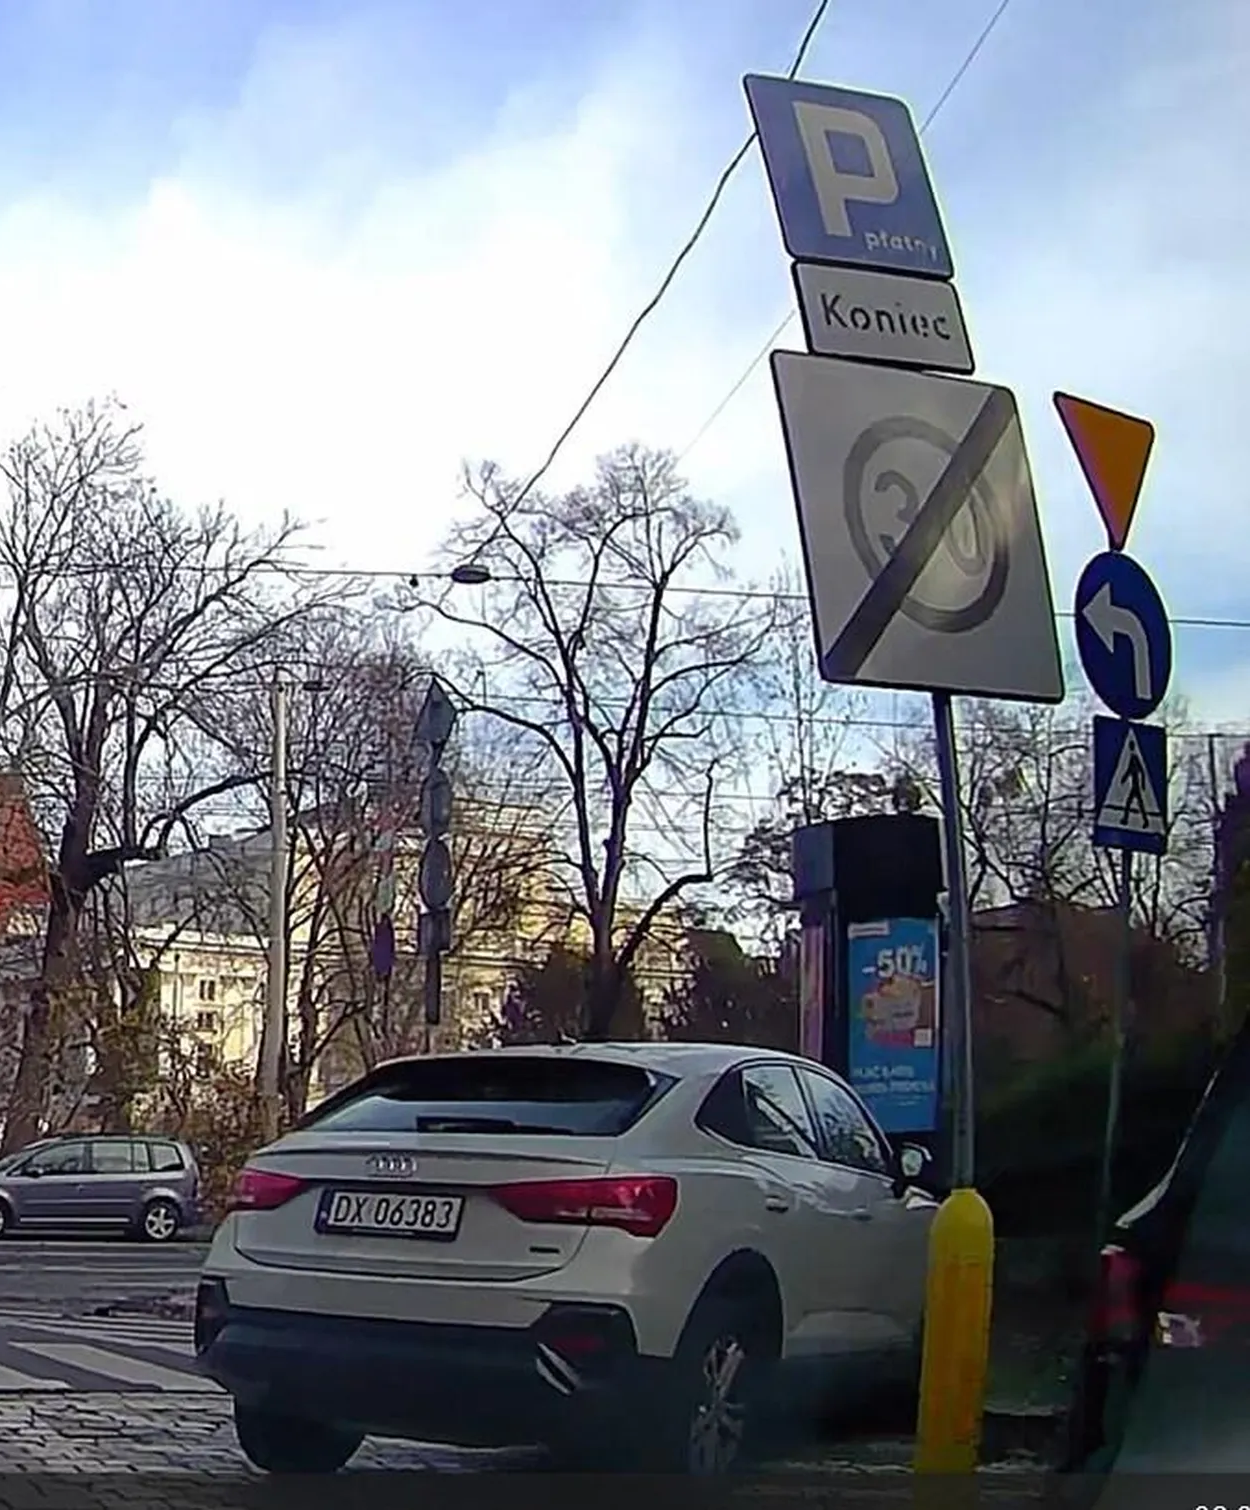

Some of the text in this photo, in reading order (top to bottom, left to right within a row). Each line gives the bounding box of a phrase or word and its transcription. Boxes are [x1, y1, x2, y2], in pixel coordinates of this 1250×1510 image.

[792, 101, 898, 236] P
[821, 293, 950, 340] Koniec
[874, 468, 995, 578] 30
[333, 1195, 453, 1228] DX 06383
